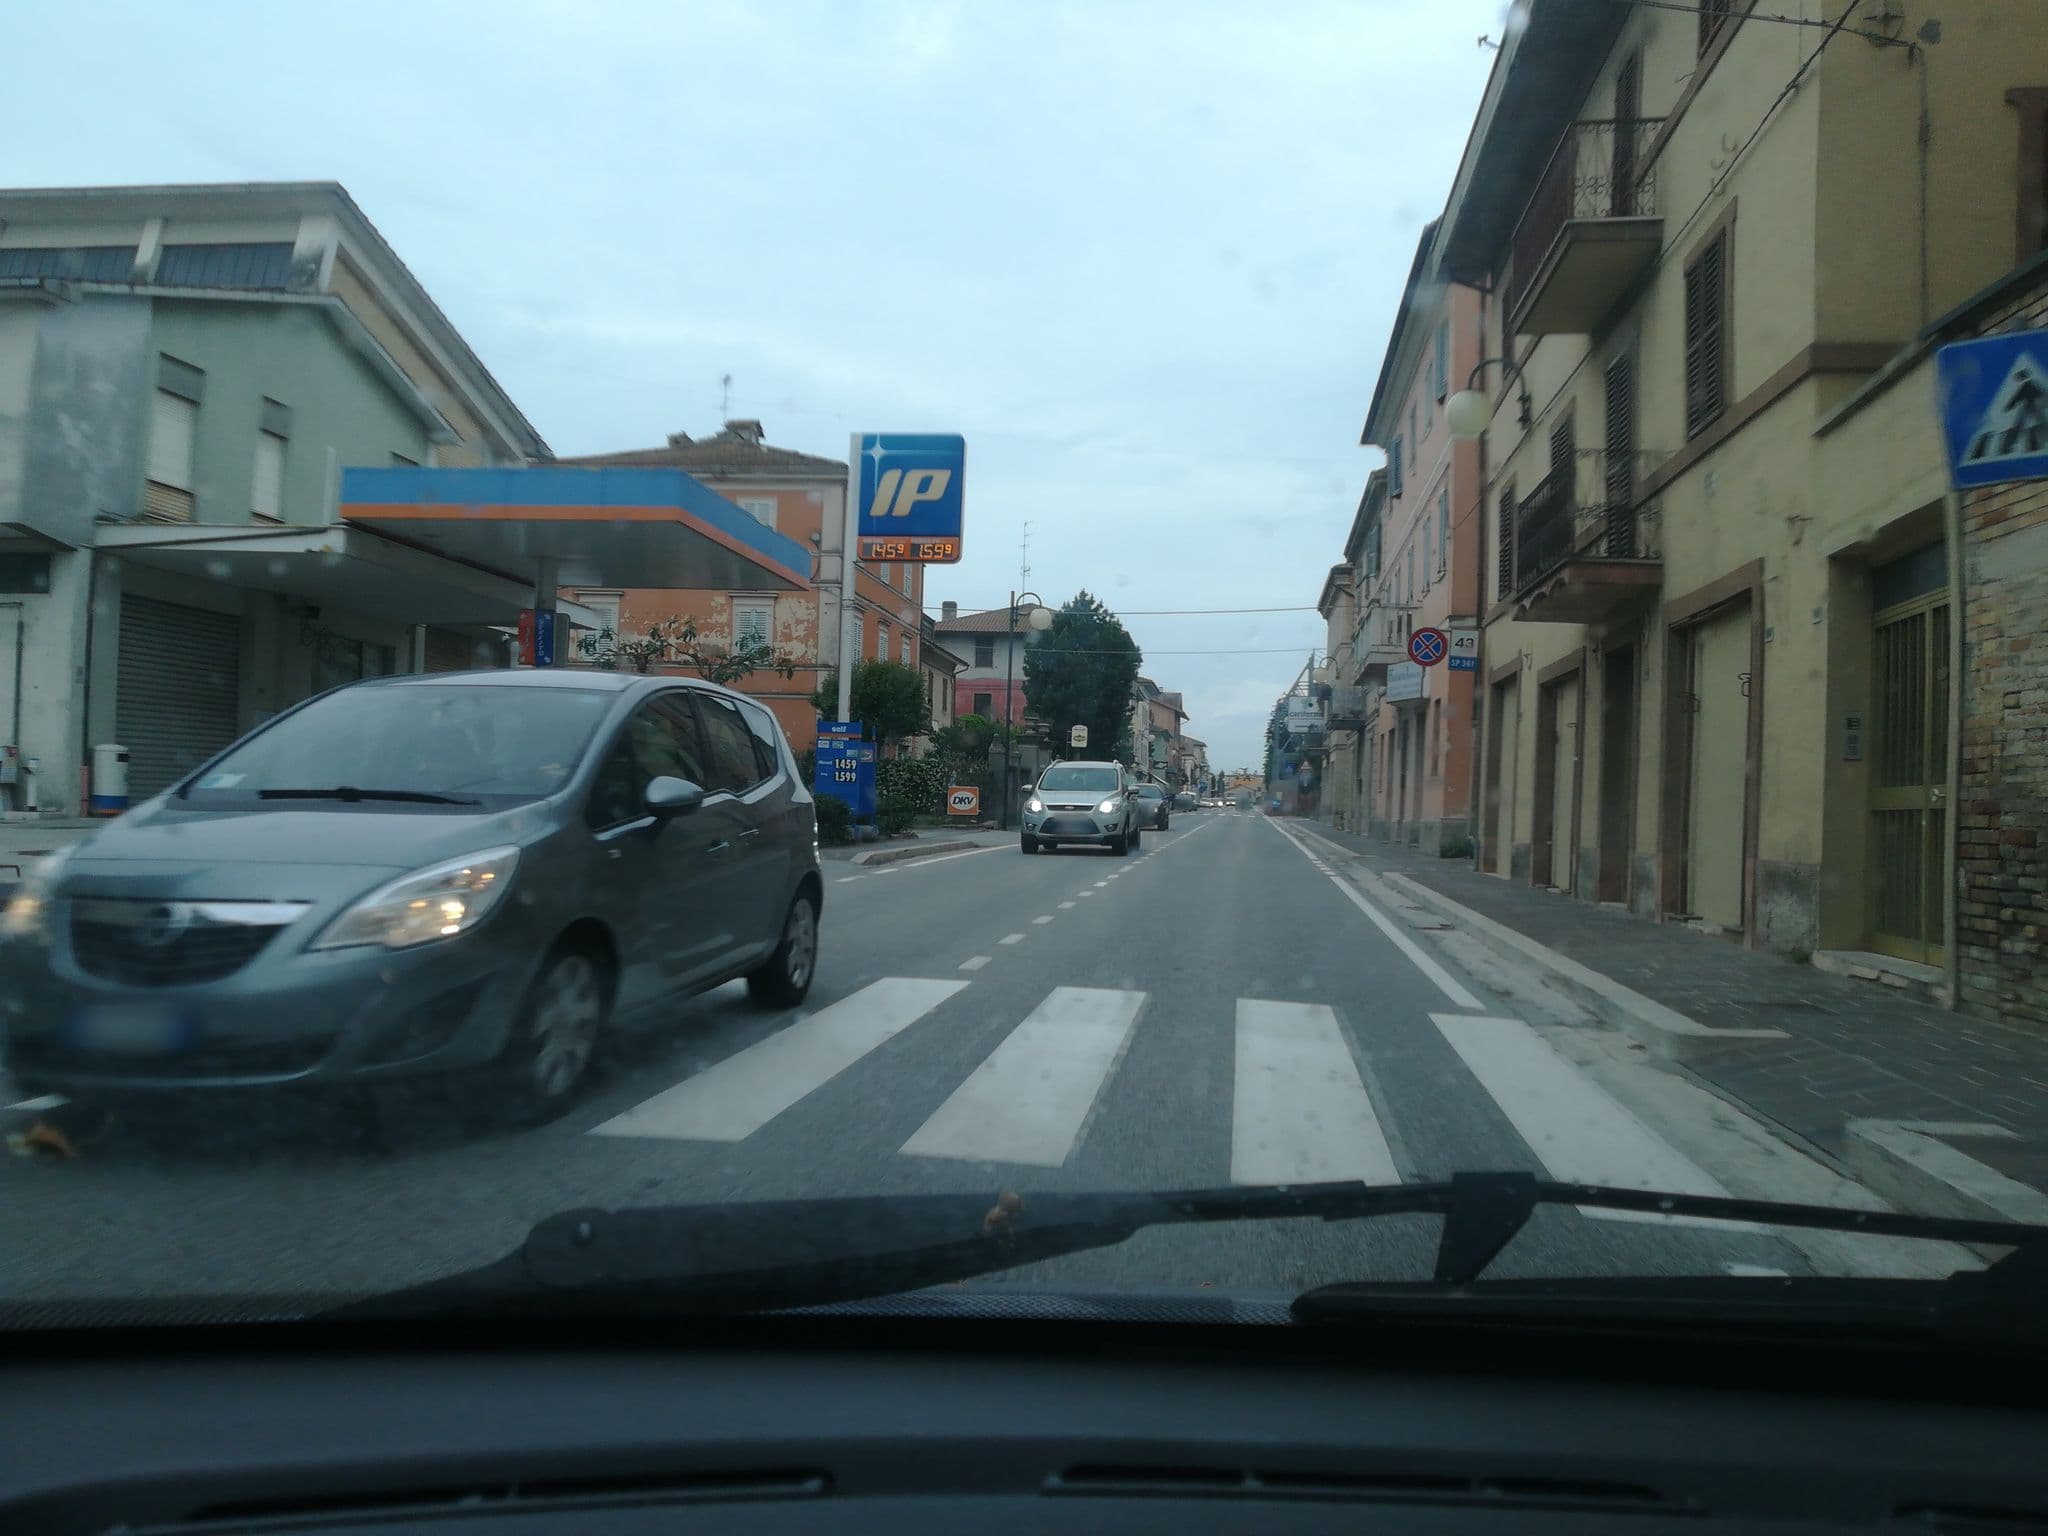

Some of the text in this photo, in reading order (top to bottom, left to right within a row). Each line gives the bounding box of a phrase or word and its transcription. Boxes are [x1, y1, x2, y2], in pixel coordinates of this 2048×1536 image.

[869, 468, 951, 517] IP
[1455, 637, 1474, 648] 43
[952, 796, 975, 805] DKV
